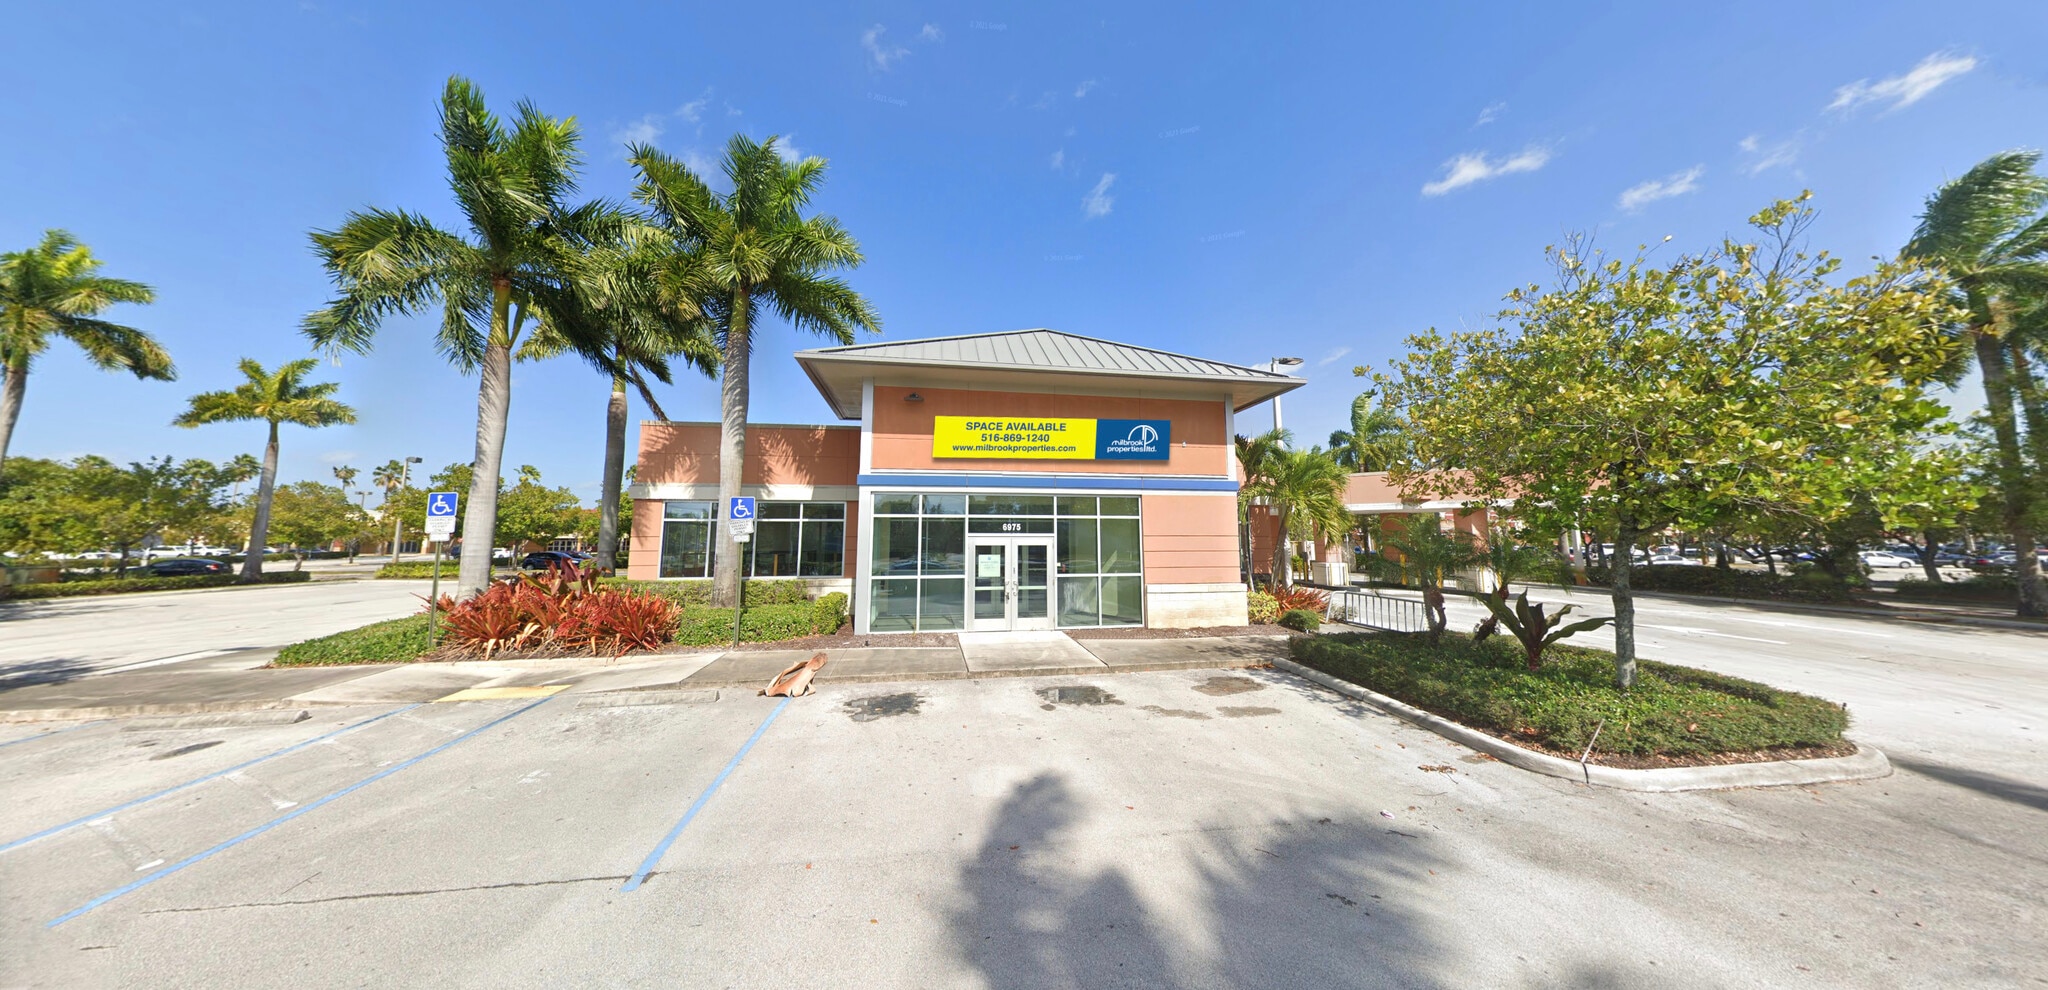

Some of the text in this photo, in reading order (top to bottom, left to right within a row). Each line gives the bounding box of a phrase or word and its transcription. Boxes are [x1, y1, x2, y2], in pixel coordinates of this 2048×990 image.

[965, 421, 1067, 432] SPACE AVAILABLE
[981, 433, 1050, 442] 516-869-1240
[1111, 438, 1144, 446] milbrook
[952, 443, 1076, 453] www.milbrookproperties.com
[1106, 445, 1144, 453] properties
[1002, 523, 1021, 531] 6975
